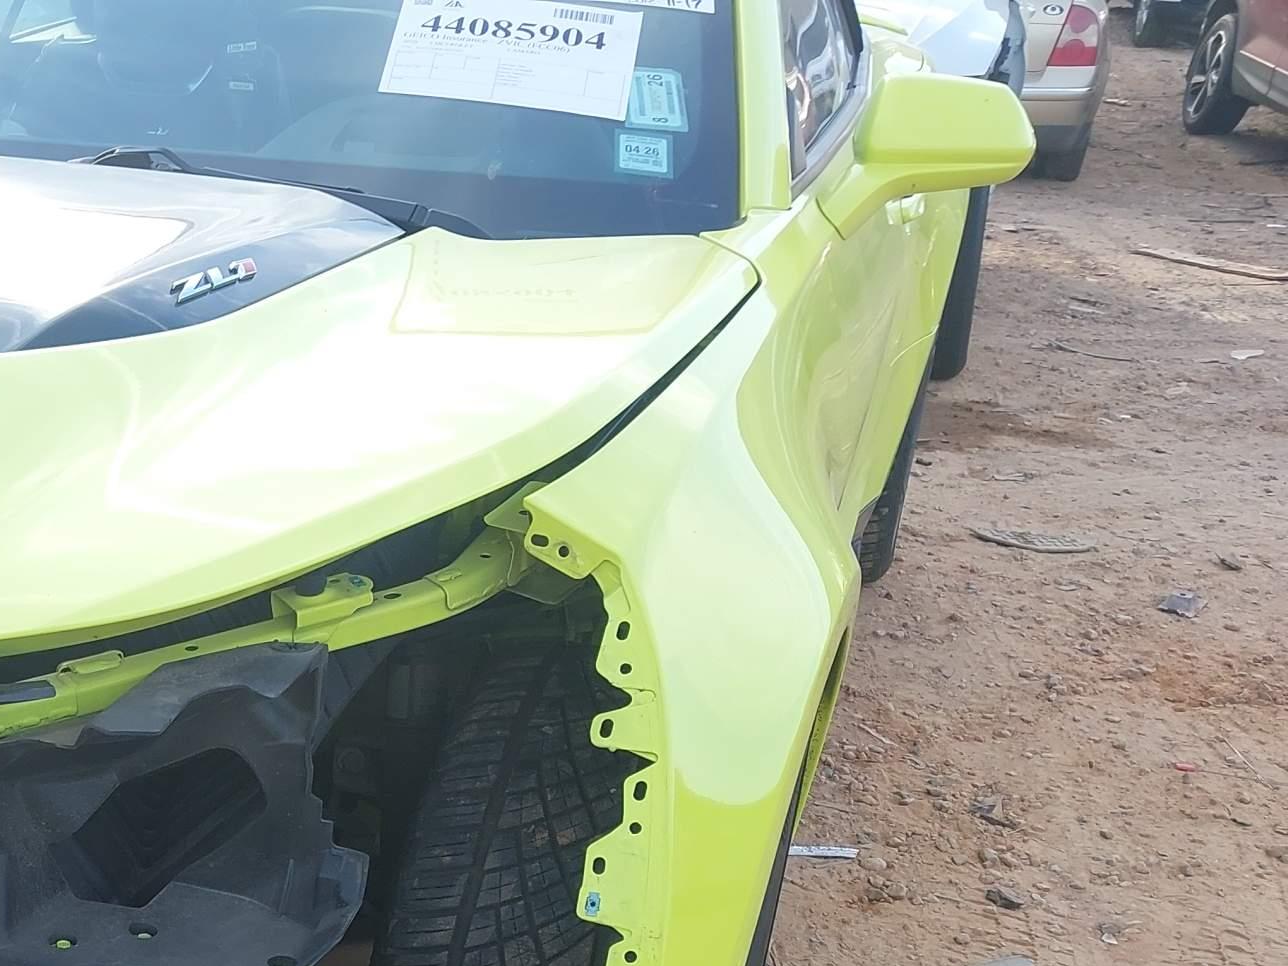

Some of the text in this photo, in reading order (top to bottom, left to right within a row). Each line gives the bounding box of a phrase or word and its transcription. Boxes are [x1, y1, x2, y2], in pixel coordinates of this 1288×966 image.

[421, 14, 607, 50] 44085904
[442, 34, 489, 43] Insurance
[647, 73, 663, 87] 26
[170, 258, 257, 305] ZL1
